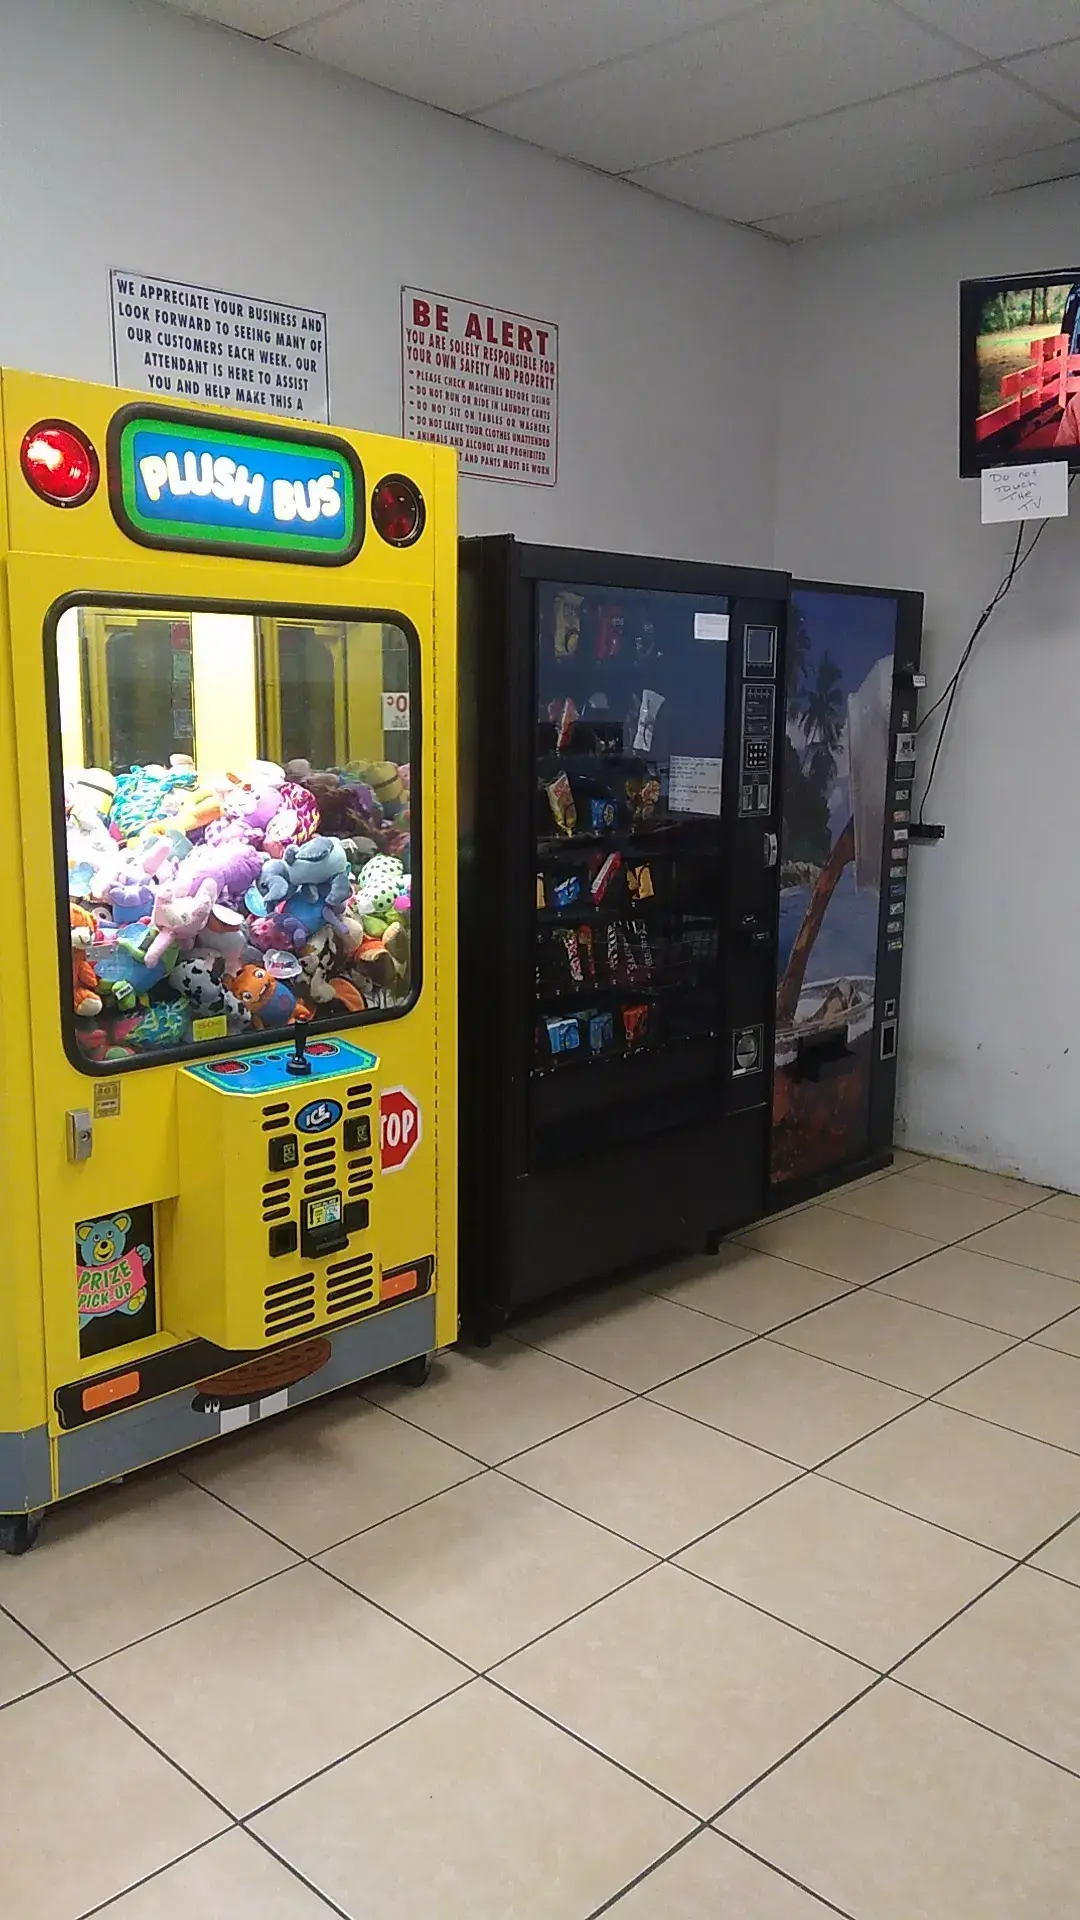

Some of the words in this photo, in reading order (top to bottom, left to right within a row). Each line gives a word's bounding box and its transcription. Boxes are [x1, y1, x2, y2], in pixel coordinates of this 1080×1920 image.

[117, 279, 134, 295] WE
[140, 284, 208, 310] APPRECIATE
[214, 300, 243, 317] YOUR
[249, 306, 296, 327] BUSINESS
[302, 317, 321, 332] AND
[118, 302, 149, 321] LOOK
[156, 310, 211, 332] FORWARD
[216, 321, 229, 335] TO
[235, 325, 270, 343] SEEING
[276, 334, 305, 350] MANY
[311, 340, 322, 353] OF
[413, 298, 448, 332] BE
[465, 313, 548, 356] ALERT
[128, 327, 151, 343] OUR
[158, 332, 222, 355] CUSTOMERS
[228, 345, 254, 361] EACH
[260, 351, 292, 368] WEEK.
[296, 358, 316, 372] OUR
[406, 328, 424, 345] YOU
[429, 333, 445, 350] ARE
[450, 339, 479, 357] SOLELY
[484, 346, 536, 371] RESPONSIBLE
[540, 359, 554, 375] FOR
[145, 352, 207, 375] ATTENDANT
[214, 364, 222, 377] IS
[228, 368, 254, 382] HERE
[259, 371, 270, 385] TO
[276, 374, 308, 391] ASSIST
[407, 346, 431, 364] YOUR
[436, 352, 456, 369] OWN
[460, 359, 489, 376] SAFETY
[493, 366, 509, 380] AND
[514, 370, 554, 390] PROPERTY
[148, 374, 171, 390] YOU
[177, 379, 199, 395] AND
[205, 384, 230, 399] HELP
[236, 388, 266, 405] MAKE
[270, 394, 292, 409] THIS
[297, 398, 303, 410] A
[417, 370, 441, 384] PLEASE
[445, 376, 465, 388] CHECK
[469, 381, 502, 396] MACHINES
[506, 388, 528, 402] BEFORE
[532, 394, 550, 406] USING
[417, 385, 426, 395] DO
[429, 388, 442, 399] NOT
[446, 391, 459, 402] RUN
[463, 395, 470, 404] OR
[474, 397, 488, 408] RIDE
[492, 400, 498, 409] IN
[501, 402, 529, 416] LAUNDRY
[532, 409, 550, 420] CARTS
[417, 401, 427, 410] DO
[432, 404, 446, 414] NOT
[450, 407, 460, 417] SIT
[465, 410, 474, 419] ON
[479, 412, 502, 425] TABLES
[507, 418, 515, 427] OR
[519, 420, 550, 433] WASHERS
[417, 416, 426, 425] DO
[429, 418, 442, 428] NOT
[444, 421, 463, 432] LEAVE
[466, 424, 482, 435] YOUR
[485, 428, 510, 440] CLOTHES
[513, 433, 550, 447] UNATTENDED
[417, 431, 447, 444] ANIMALS
[450, 436, 463, 446] AND
[466, 440, 494, 452] ALCOHOL
[497, 445, 508, 454] ARE
[511, 447, 545, 460] PROHIBITED
[465, 453, 478, 463] AND
[481, 456, 500, 467] PANTS
[503, 460, 519, 470] MUST
[522, 463, 529, 471] BE
[532, 464, 550, 474] WORN
[139, 451, 264, 514] PLUSH
[273, 474, 340, 522] BUS
[989, 474, 1009, 482] Do
[1019, 469, 1037, 478] not
[1018, 496, 1041, 511] TV
[306, 1104, 330, 1126] ICE
[381, 1110, 414, 1150] TOP
[78, 1260, 132, 1290] PRIZE
